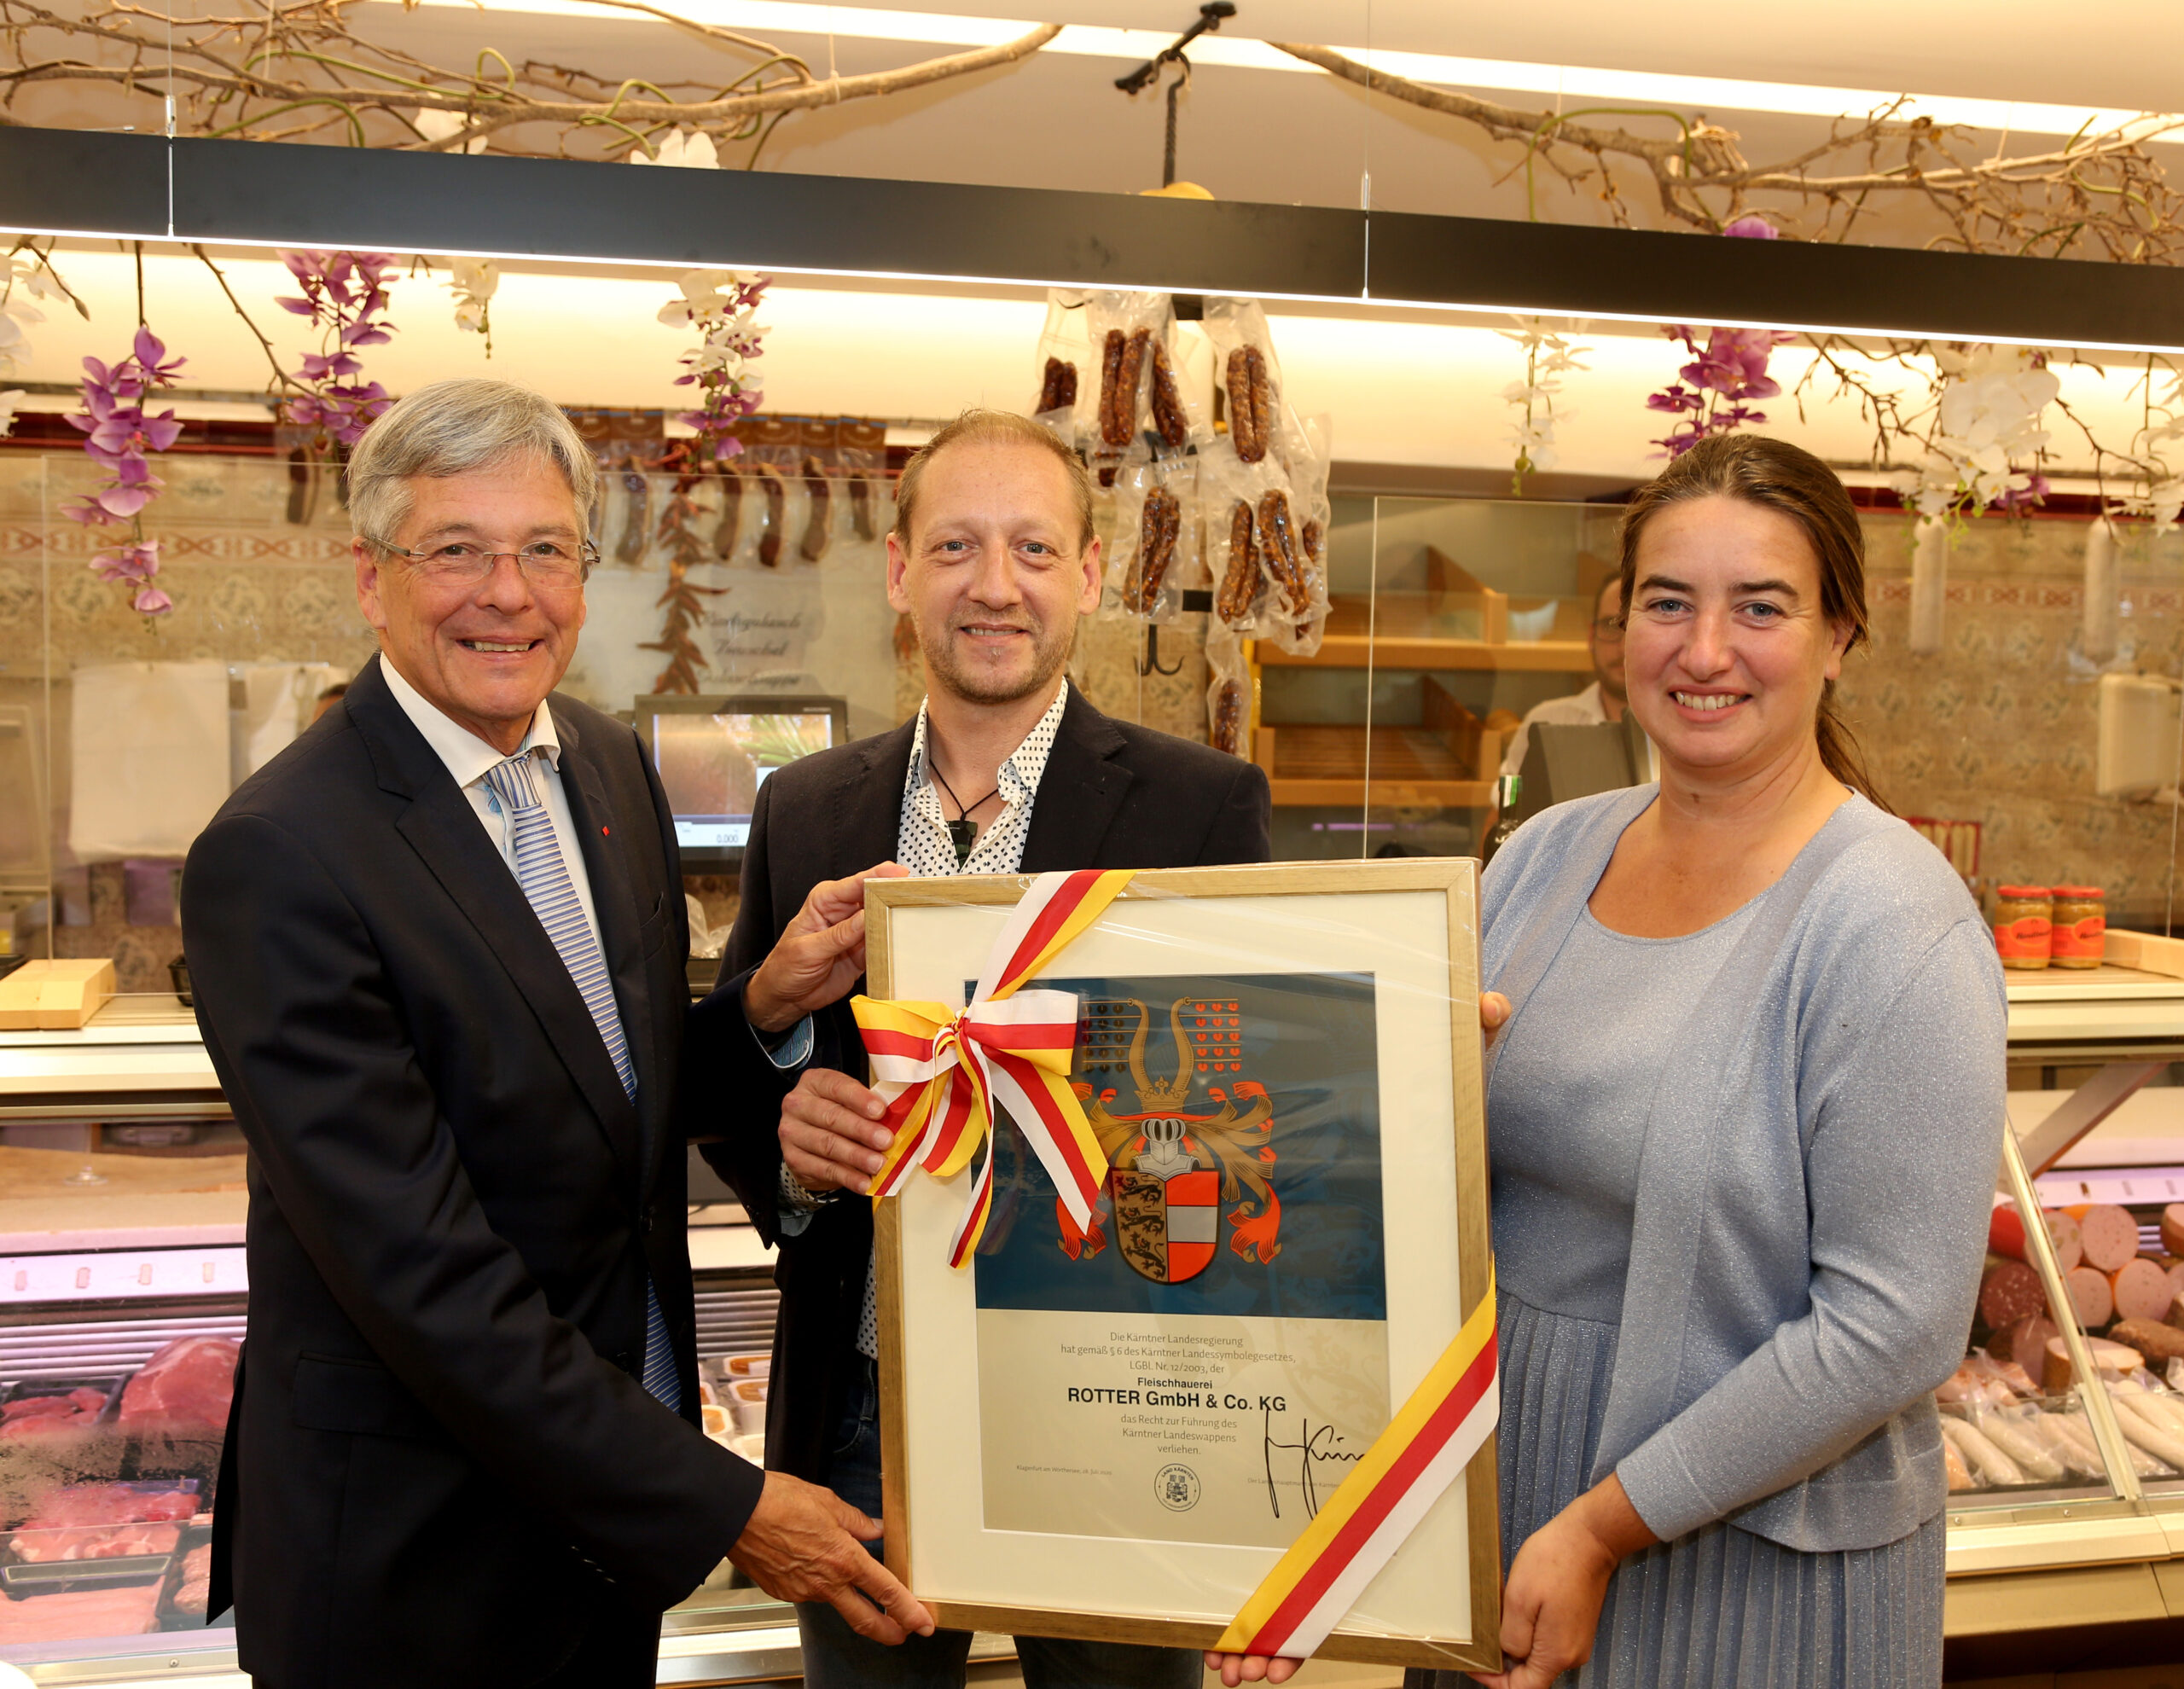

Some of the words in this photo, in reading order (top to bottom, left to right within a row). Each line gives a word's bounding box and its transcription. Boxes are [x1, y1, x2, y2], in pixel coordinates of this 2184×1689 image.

[1110, 1332, 1125, 1342] Die
[1126, 1332, 1165, 1343] Kärntner
[1167, 1334, 1243, 1348] Landesregierung
[1060, 1344, 1076, 1353] hat
[1077, 1345, 1108, 1355] gemäß
[1110, 1347, 1115, 1356] §
[1117, 1347, 1123, 1355] 6
[1124, 1347, 1140, 1356] des
[1141, 1347, 1181, 1358] Kärntner
[1182, 1349, 1296, 1363] Landessymbolegesetzes,
[1155, 1362, 1169, 1371] Nr.
[1170, 1362, 1208, 1374] 12/2003,
[1210, 1364, 1224, 1373] der
[1137, 1377, 1212, 1390] Fleischhauerei
[1068, 1387, 1140, 1405] ROTTER
[1146, 1390, 1199, 1408] GmbH
[1205, 1394, 1217, 1408] &
[1223, 1394, 1252, 1410] Co.
[1259, 1396, 1287, 1412] KG
[1120, 1413, 1137, 1424] das
[1138, 1414, 1164, 1425] Recht
[1165, 1417, 1180, 1425] zur
[1182, 1417, 1220, 1429] Führung
[1221, 1419, 1238, 1428] des
[1122, 1428, 1161, 1439] Kärntner
[1163, 1430, 1236, 1443] Landeswappens
[1157, 1444, 1201, 1454] verliehen.
